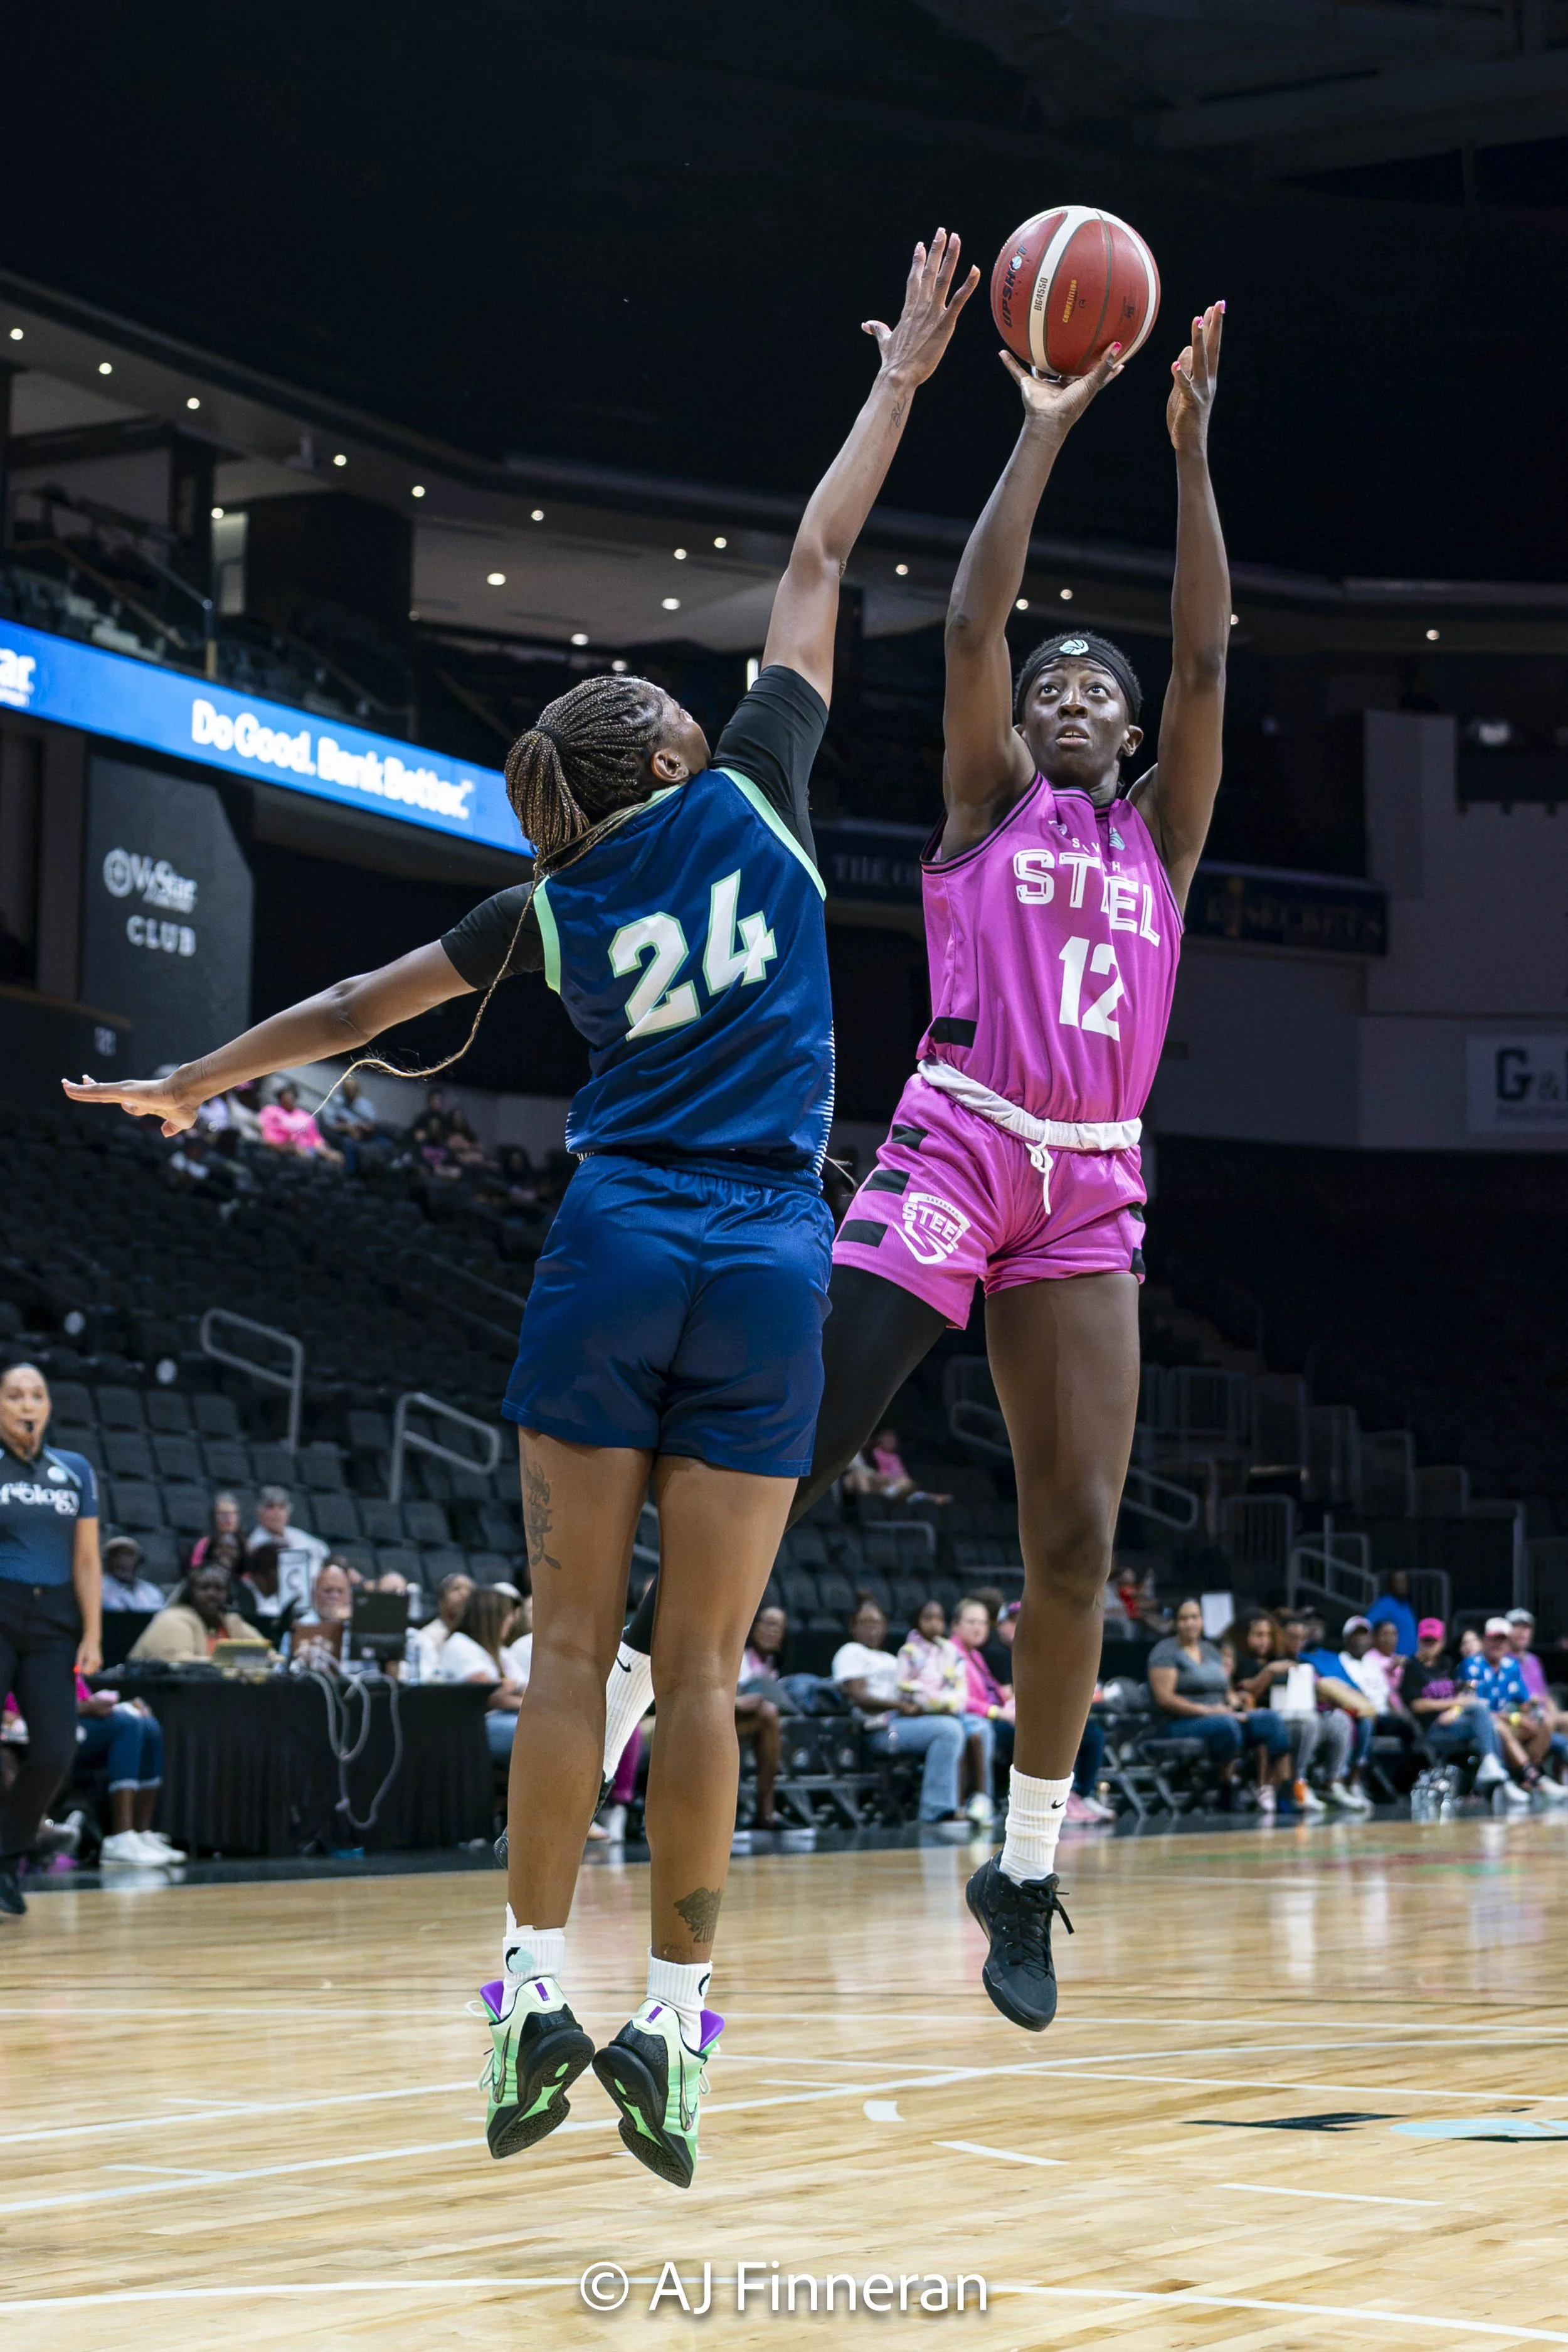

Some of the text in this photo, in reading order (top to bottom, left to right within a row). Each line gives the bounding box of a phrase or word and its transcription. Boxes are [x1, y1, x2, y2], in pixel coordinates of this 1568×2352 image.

[192, 698, 234, 751] Do
[234, 712, 315, 776] Good.
[317, 736, 384, 796] Bank
[127, 914, 196, 958] CLUB
[1013, 849, 1160, 948] STEL
[608, 869, 778, 1042] 24
[1058, 935, 1125, 1042] 12
